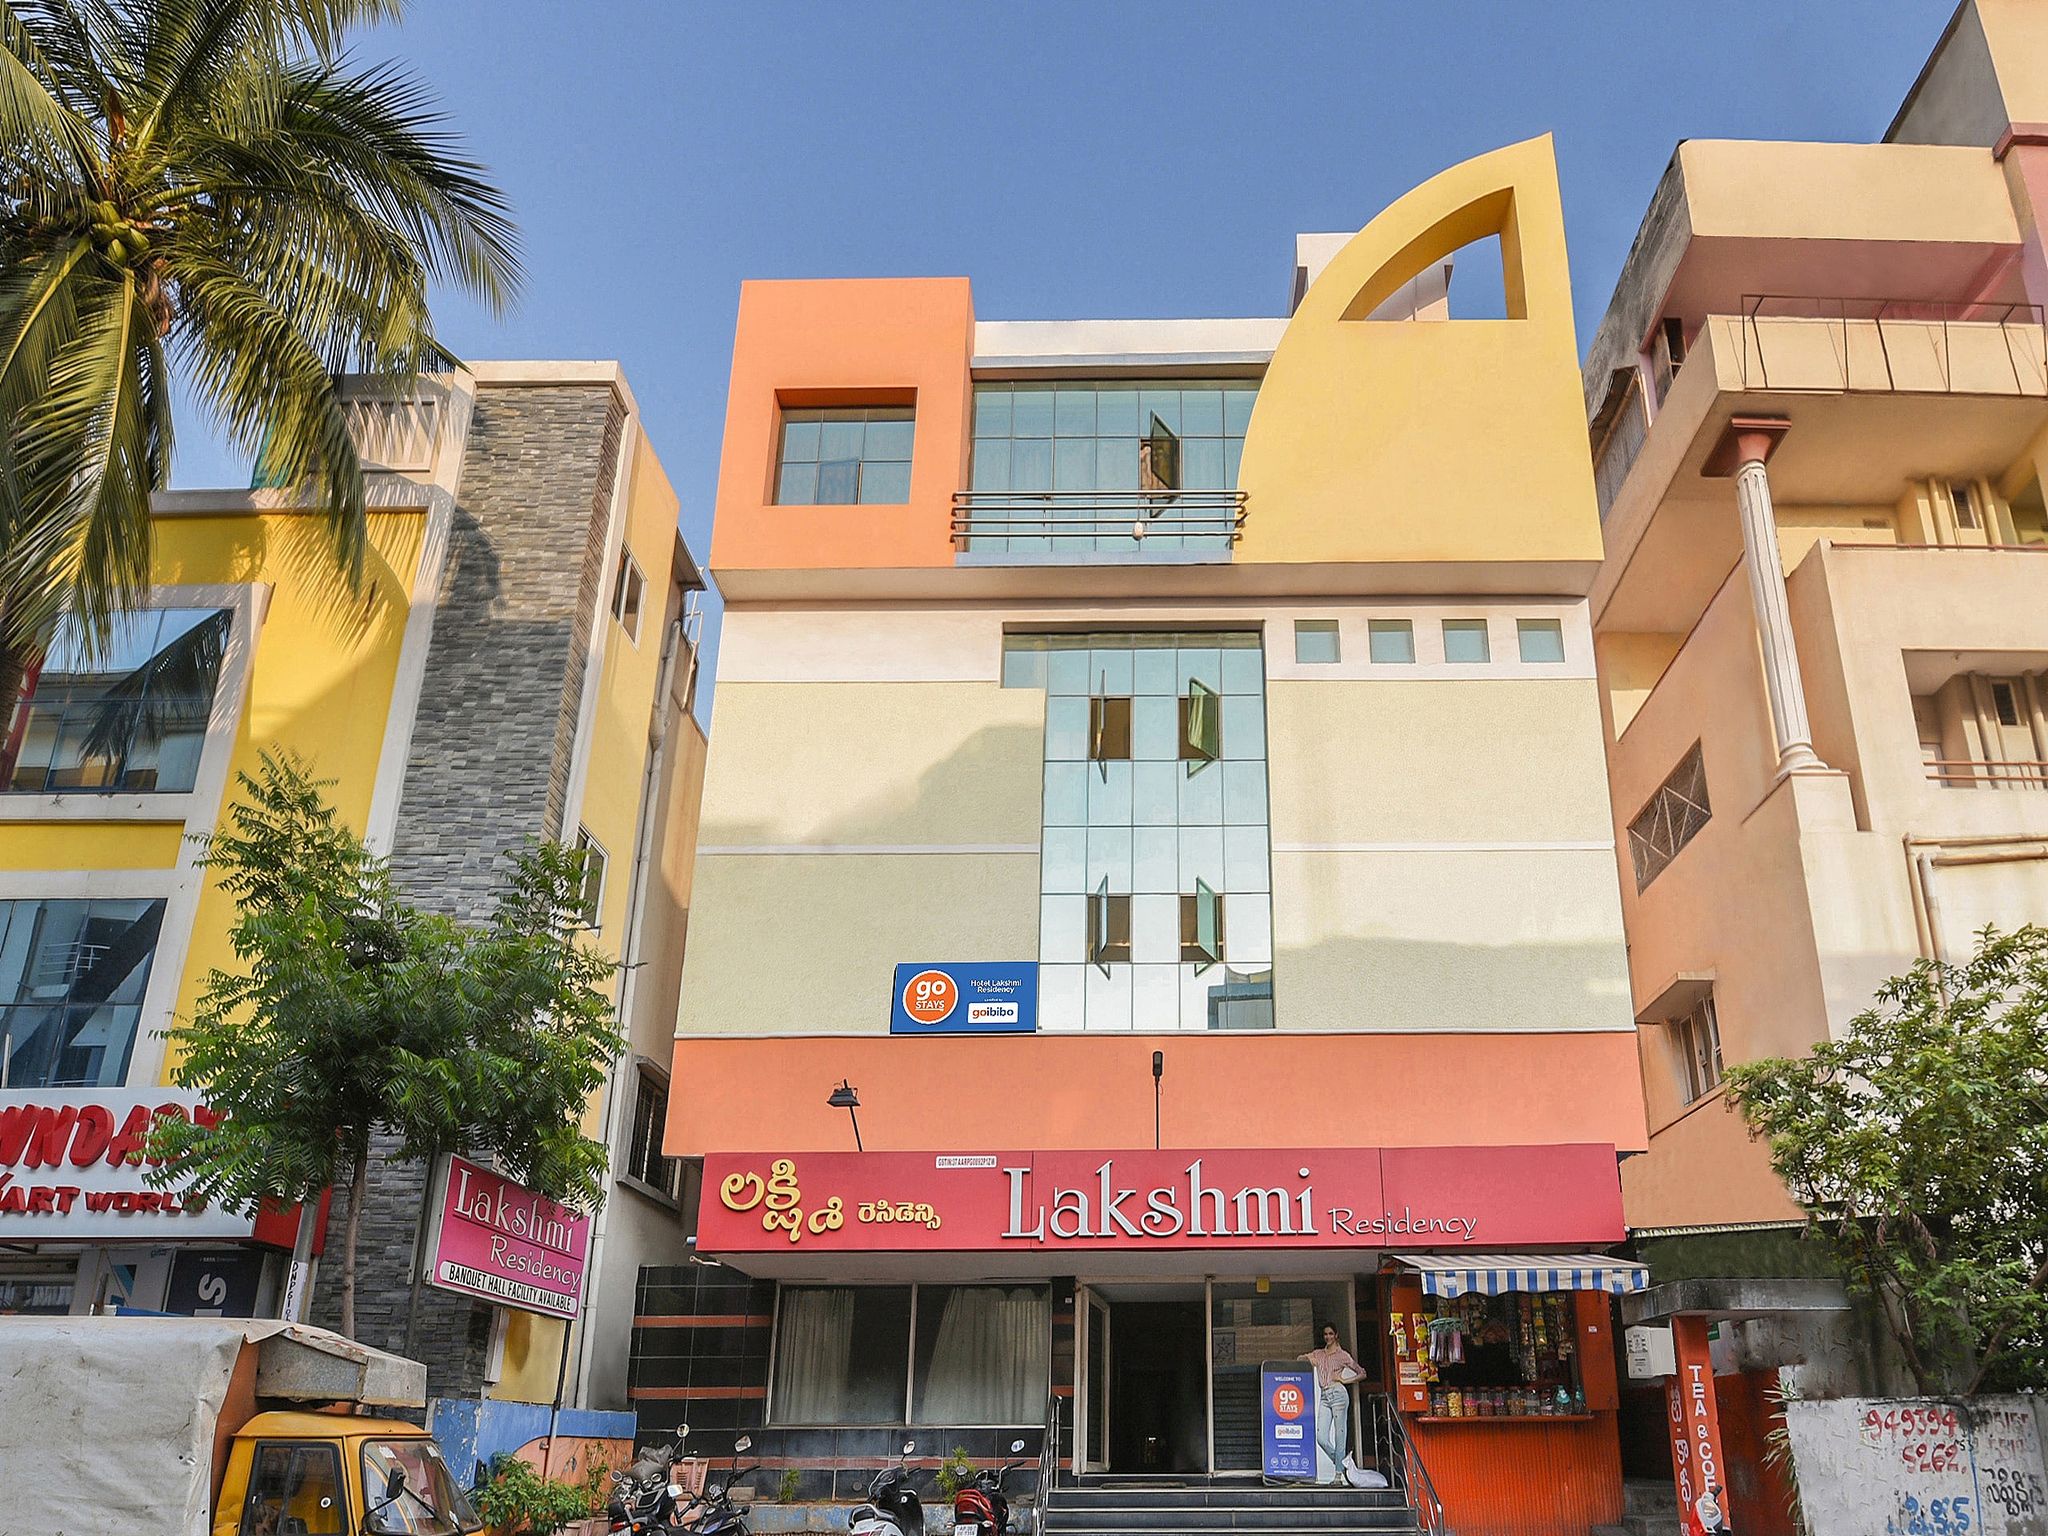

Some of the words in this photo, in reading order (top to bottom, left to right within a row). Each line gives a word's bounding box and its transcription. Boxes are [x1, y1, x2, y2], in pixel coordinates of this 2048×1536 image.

[970, 979, 991, 987] Hotel
[992, 978, 1022, 987] Lakshmi
[977, 986, 1014, 994] Residency
[916, 980, 947, 1001] go
[915, 1000, 945, 1010] STAYS
[972, 1006, 1014, 1019] goibibo
[1001, 1158, 1319, 1243] Lakshmi
[1328, 1207, 1478, 1240] Residency
[454, 1168, 574, 1253] Lakshmi
[490, 1234, 581, 1294] Residency
[449, 1264, 487, 1290] BANQUET
[488, 1275, 506, 1296] HALL
[507, 1282, 538, 1303] FACILITY
[538, 1290, 572, 1311] AVAILABLE
[1279, 1390, 1297, 1404] go
[1688, 1364, 1708, 1417] TEA
[1279, 1404, 1298, 1412] STAYS
[1697, 1424, 1709, 1439] &
